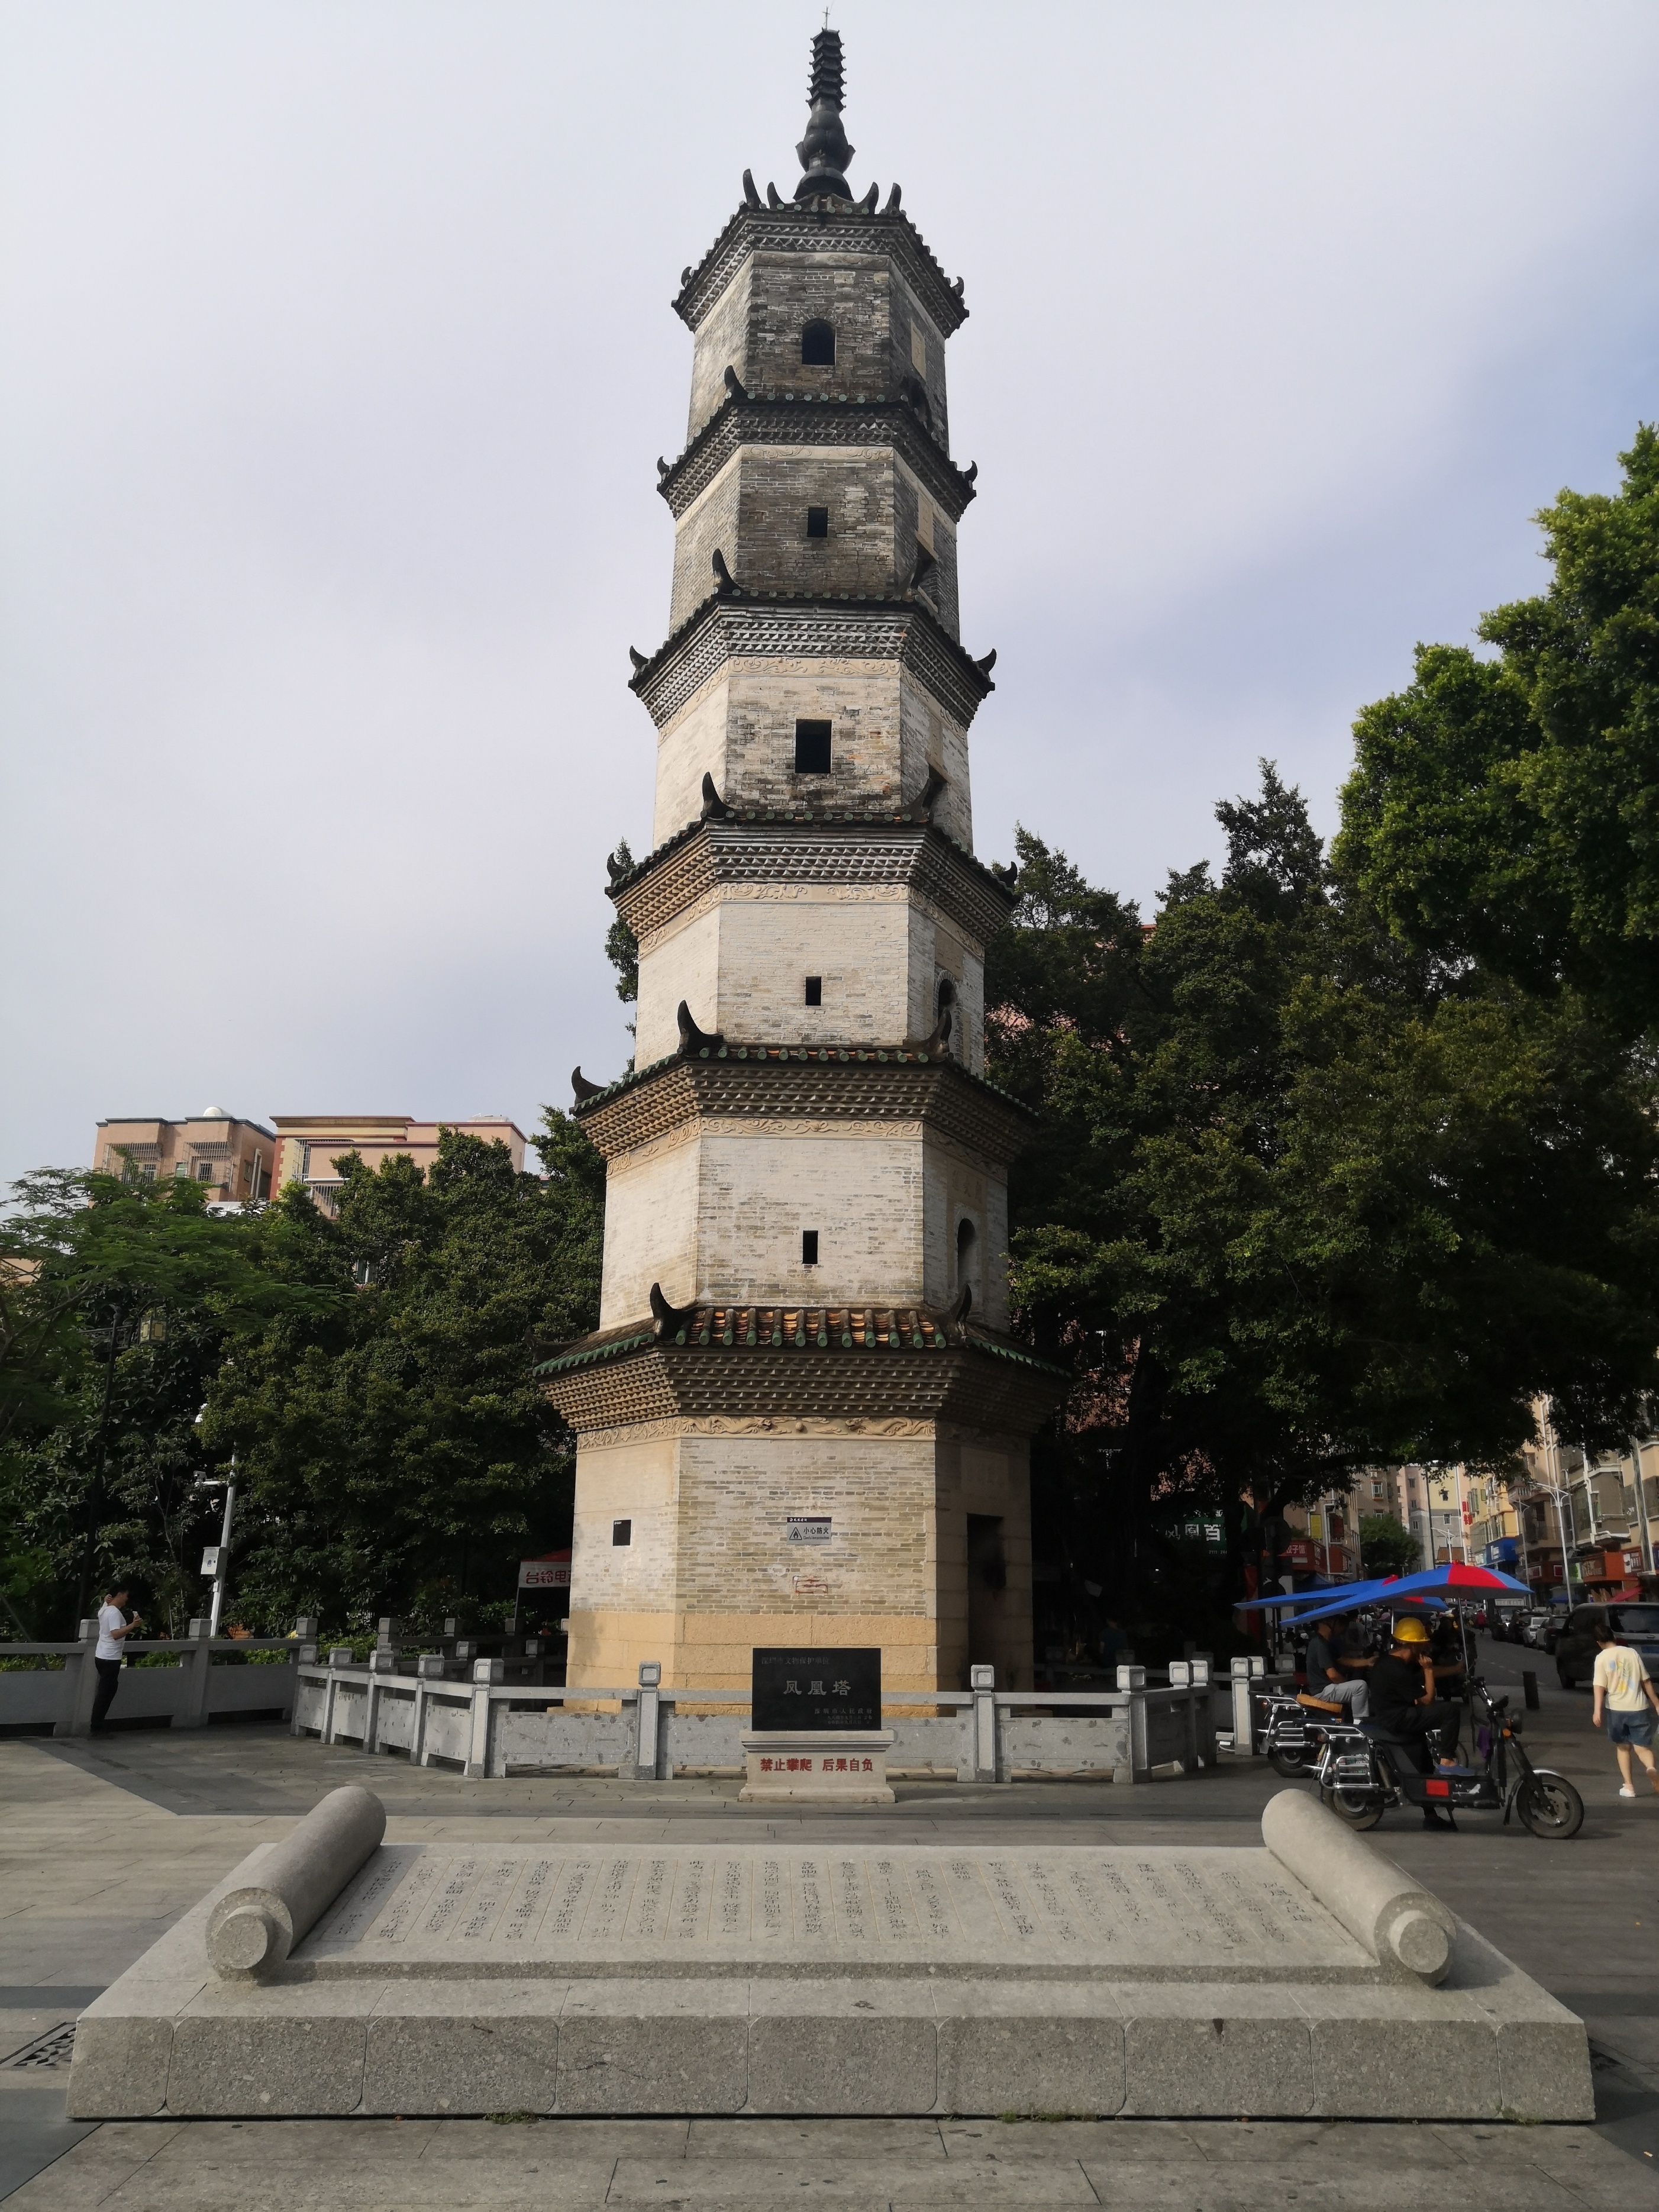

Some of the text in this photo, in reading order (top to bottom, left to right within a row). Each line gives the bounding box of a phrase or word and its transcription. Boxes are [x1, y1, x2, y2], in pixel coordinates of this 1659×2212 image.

[526, 1570, 571, 1584] 台铃电
[783, 1679, 851, 1696] 凤凰塔
[760, 1758, 873, 1772] 禁止攀爬 后果自负
